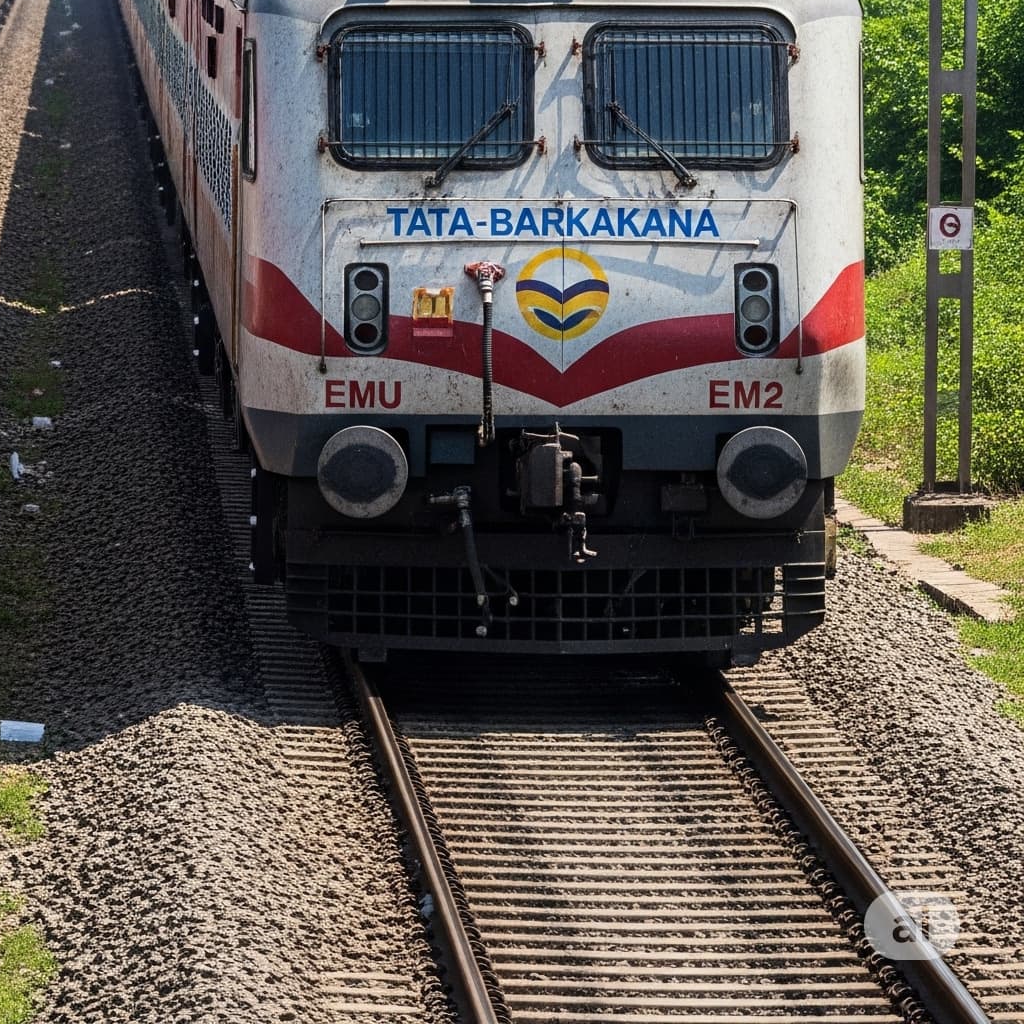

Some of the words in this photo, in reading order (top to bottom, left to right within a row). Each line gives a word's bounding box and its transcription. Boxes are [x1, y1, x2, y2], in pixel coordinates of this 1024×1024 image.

[387, 207, 720, 238] TATA-BARKAKANA
[325, 379, 402, 409] EMU
[708, 380, 784, 409] EM2
